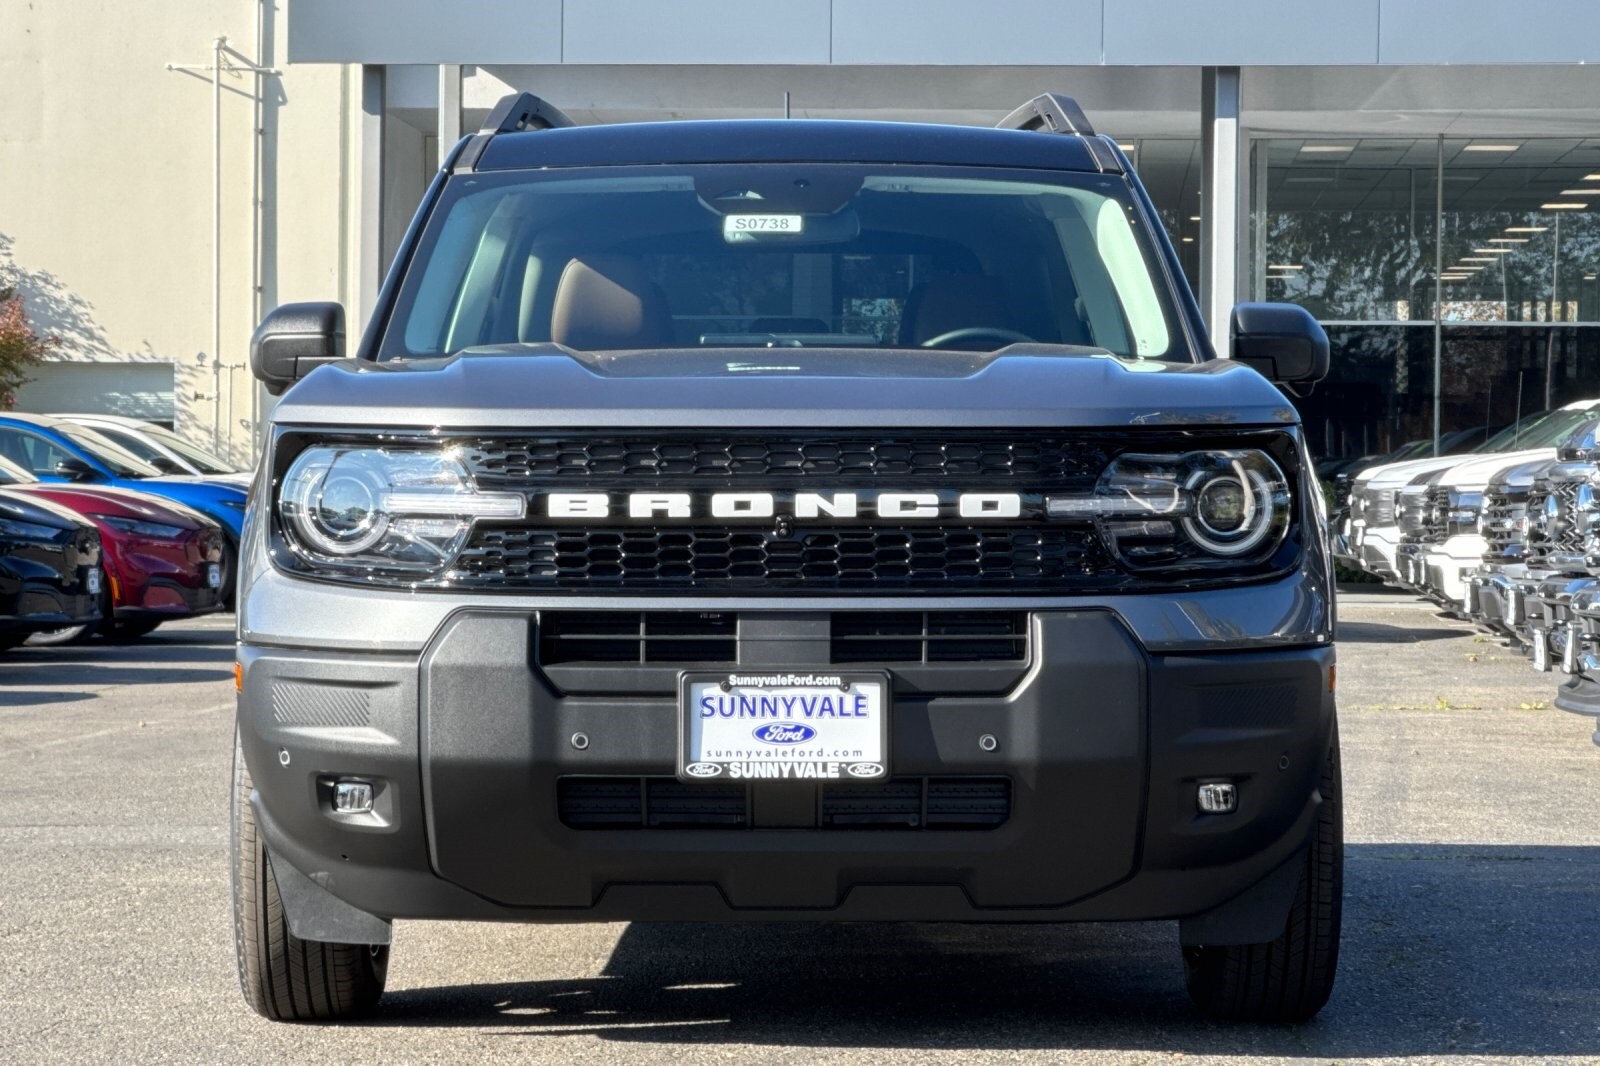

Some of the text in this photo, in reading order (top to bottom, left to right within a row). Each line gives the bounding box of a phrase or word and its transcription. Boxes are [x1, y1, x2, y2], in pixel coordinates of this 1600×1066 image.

[735, 218, 789, 230] S0738
[547, 493, 1021, 518] BRONCO
[729, 675, 841, 688] SunnyvaleFord.com
[701, 694, 869, 719] SUNNYVALE
[764, 724, 805, 742] Ford
[706, 748, 863, 758] sunnyvaleford.com
[729, 762, 840, 778] SUNNYVALE
